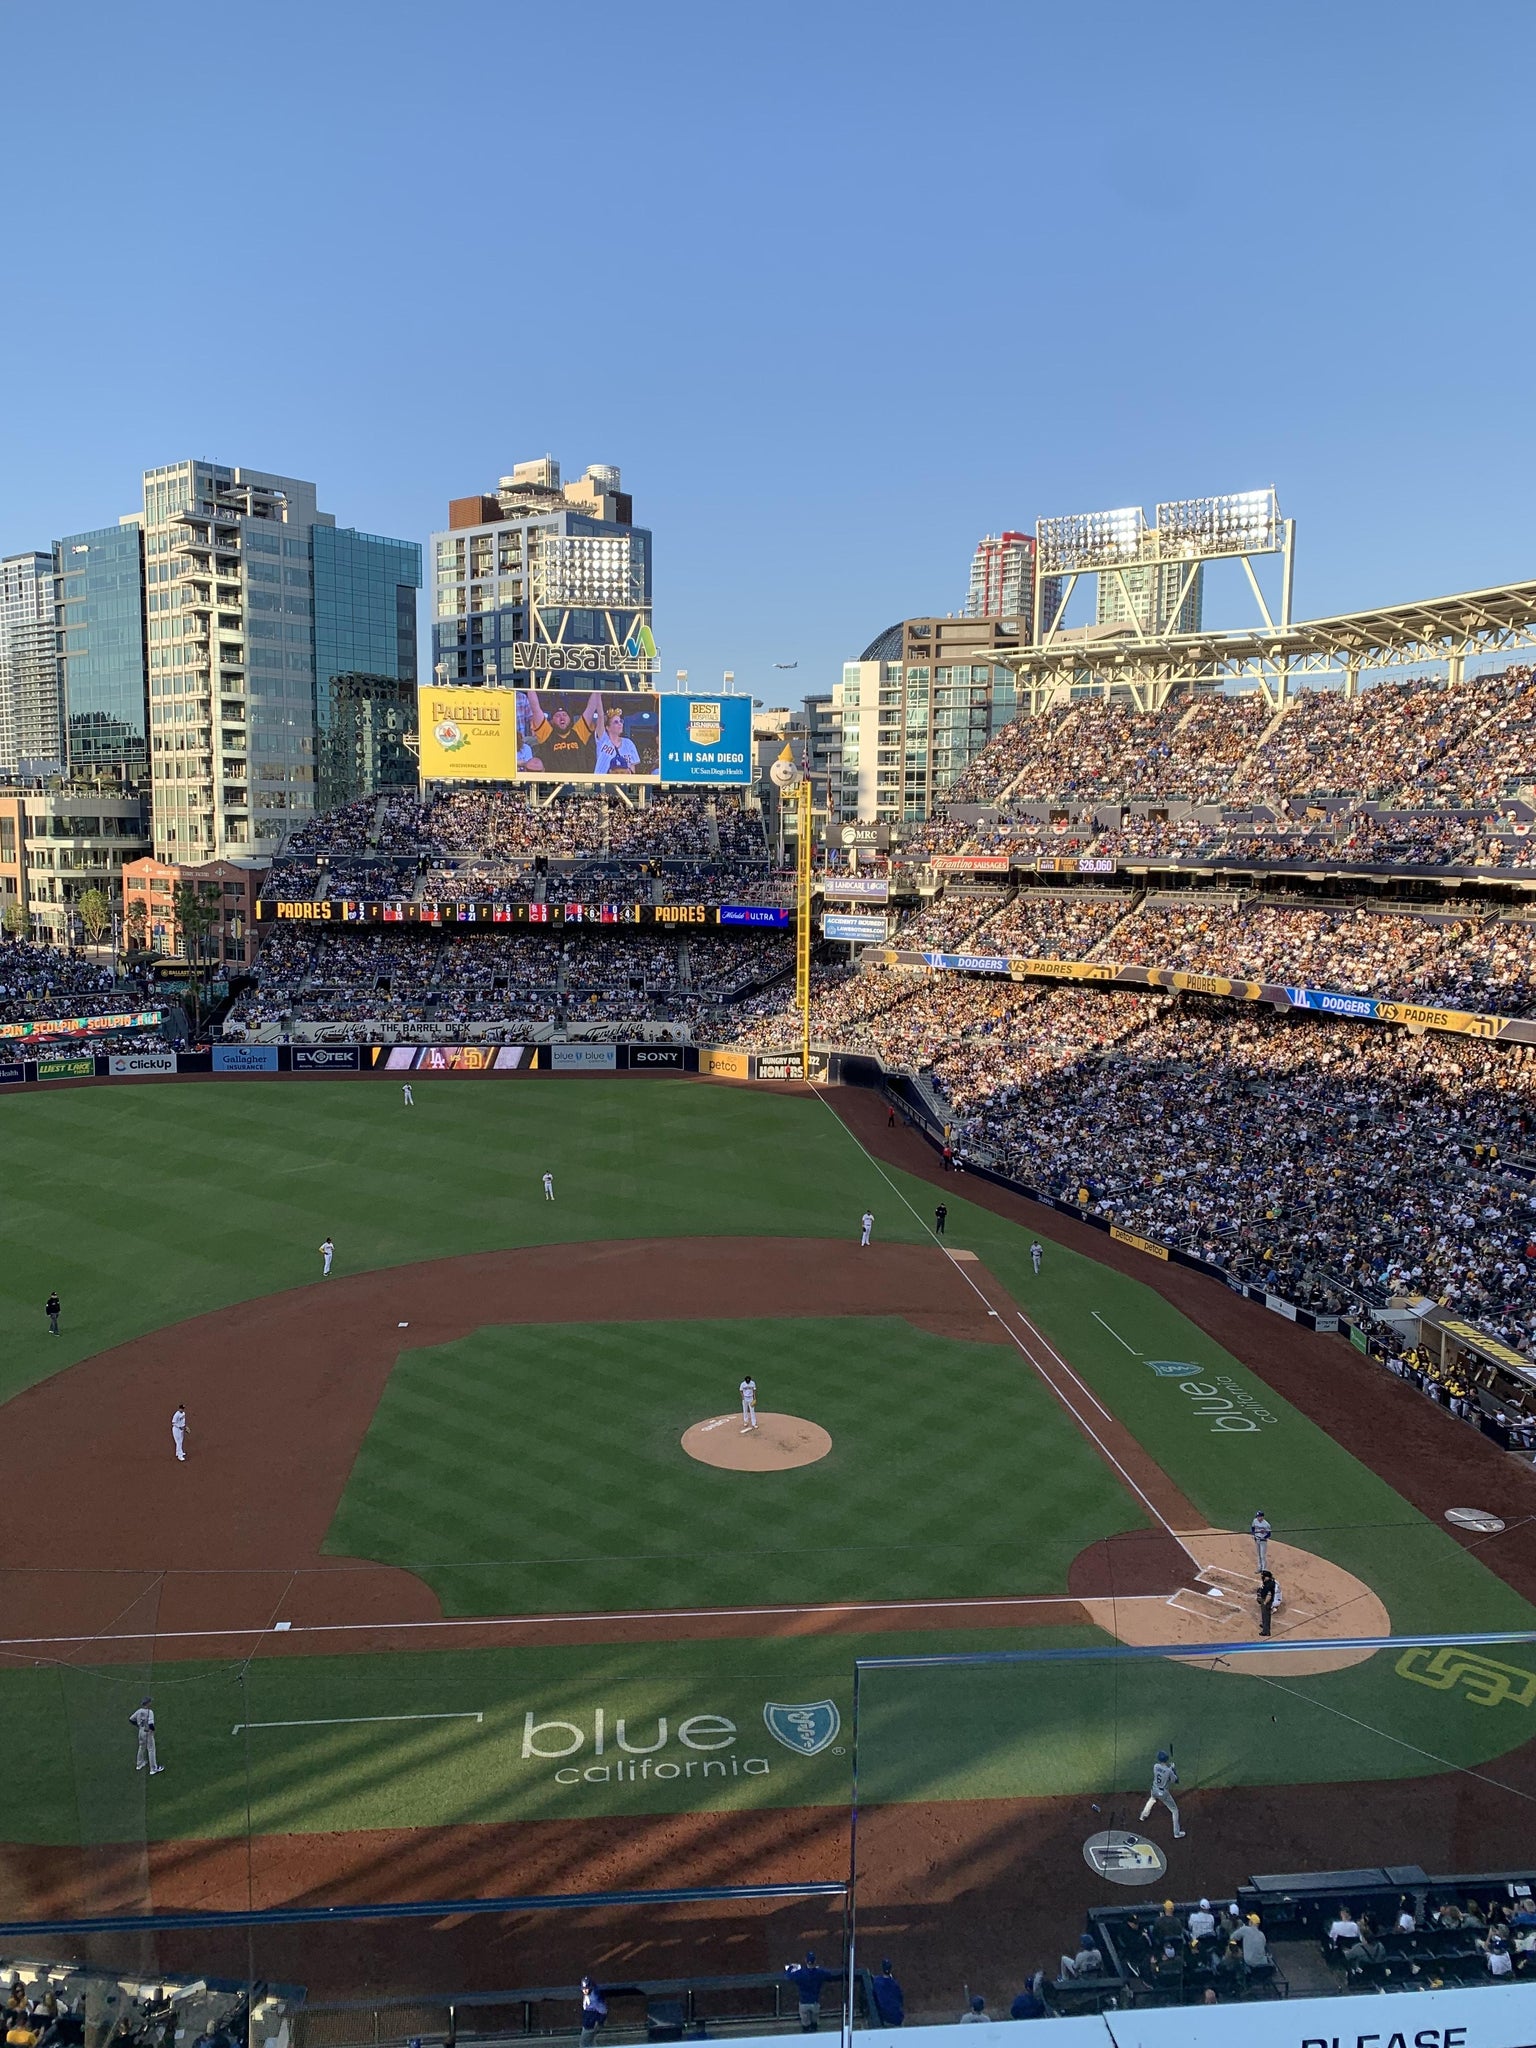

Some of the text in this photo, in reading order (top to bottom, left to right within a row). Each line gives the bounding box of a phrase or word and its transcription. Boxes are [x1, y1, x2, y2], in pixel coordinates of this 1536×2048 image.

[517, 642, 616, 670] Viasat
[432, 702, 500, 722] PACIFICO
[692, 704, 719, 714] BEST
[472, 727, 500, 737] CLARA
[668, 752, 744, 763] #1 IN SAN DIEGO
[690, 767, 700, 775] UC
[727, 768, 744, 776] Health
[856, 830, 878, 840] MRC
[932, 857, 972, 869] Tarantino
[1079, 859, 1112, 872] $26,060
[835, 881, 887, 890] LANDCARE LOGIC
[277, 901, 332, 920] PADRES
[359, 902, 365, 911] 5
[373, 906, 379, 917] F
[396, 902, 402, 912] 0
[432, 902, 439, 912] 3
[469, 903, 475, 913] 0
[505, 903, 511, 913] 5
[541, 903, 547, 913] 5
[577, 904, 583, 914] 6
[612, 905, 618, 914] 0
[359, 911, 365, 921] 2
[395, 911, 404, 921] 13
[410, 907, 415, 917] F
[433, 911, 439, 921] 2
[446, 907, 452, 917] F
[468, 912, 476, 921] 21
[482, 907, 488, 918] F
[505, 912, 511, 922] 3
[518, 908, 524, 918] F
[554, 908, 560, 918] F
[589, 909, 595, 918] 6
[624, 908, 630, 919] 4
[655, 905, 706, 922] PADRES
[750, 911, 775, 921] ULTRA
[541, 913, 547, 922] 0
[577, 913, 583, 922] 5
[612, 914, 618, 922] 4
[957, 957, 1003, 970] DODGERS
[1011, 959, 1026, 973] VS
[1033, 963, 1073, 974] PADRES
[1186, 974, 1217, 993] PADRES
[1322, 996, 1371, 1014] DODGERS
[1379, 1003, 1396, 1019] VS
[1403, 1008, 1448, 1026] PADRES
[33, 1019, 79, 1034] SCULPIN
[88, 1016, 131, 1030] SCULPIN
[380, 1023, 471, 1032] THE BARREL DECK
[223, 1055, 267, 1064] Gallagher
[297, 1049, 354, 1064] EVOTEK
[430, 1047, 446, 1069] LA
[464, 1047, 483, 1069] SD
[553, 1051, 574, 1060] blue
[585, 1051, 605, 1060] blue
[637, 1052, 678, 1061] SONY
[762, 1056, 801, 1065] HUNGRY FOR
[40, 1063, 91, 1073] WEST LAKE
[129, 1060, 172, 1070] ClickUp
[709, 1060, 737, 1072] petco
[1115, 1230, 1133, 1243] petco
[1144, 1242, 1163, 1256] petco
[1215, 1375, 1279, 1424] california
[1179, 1381, 1262, 1432] blue
[521, 1707, 738, 1759] blue
[554, 1755, 771, 1785] california
[1156, 1773, 1162, 1784] 6
